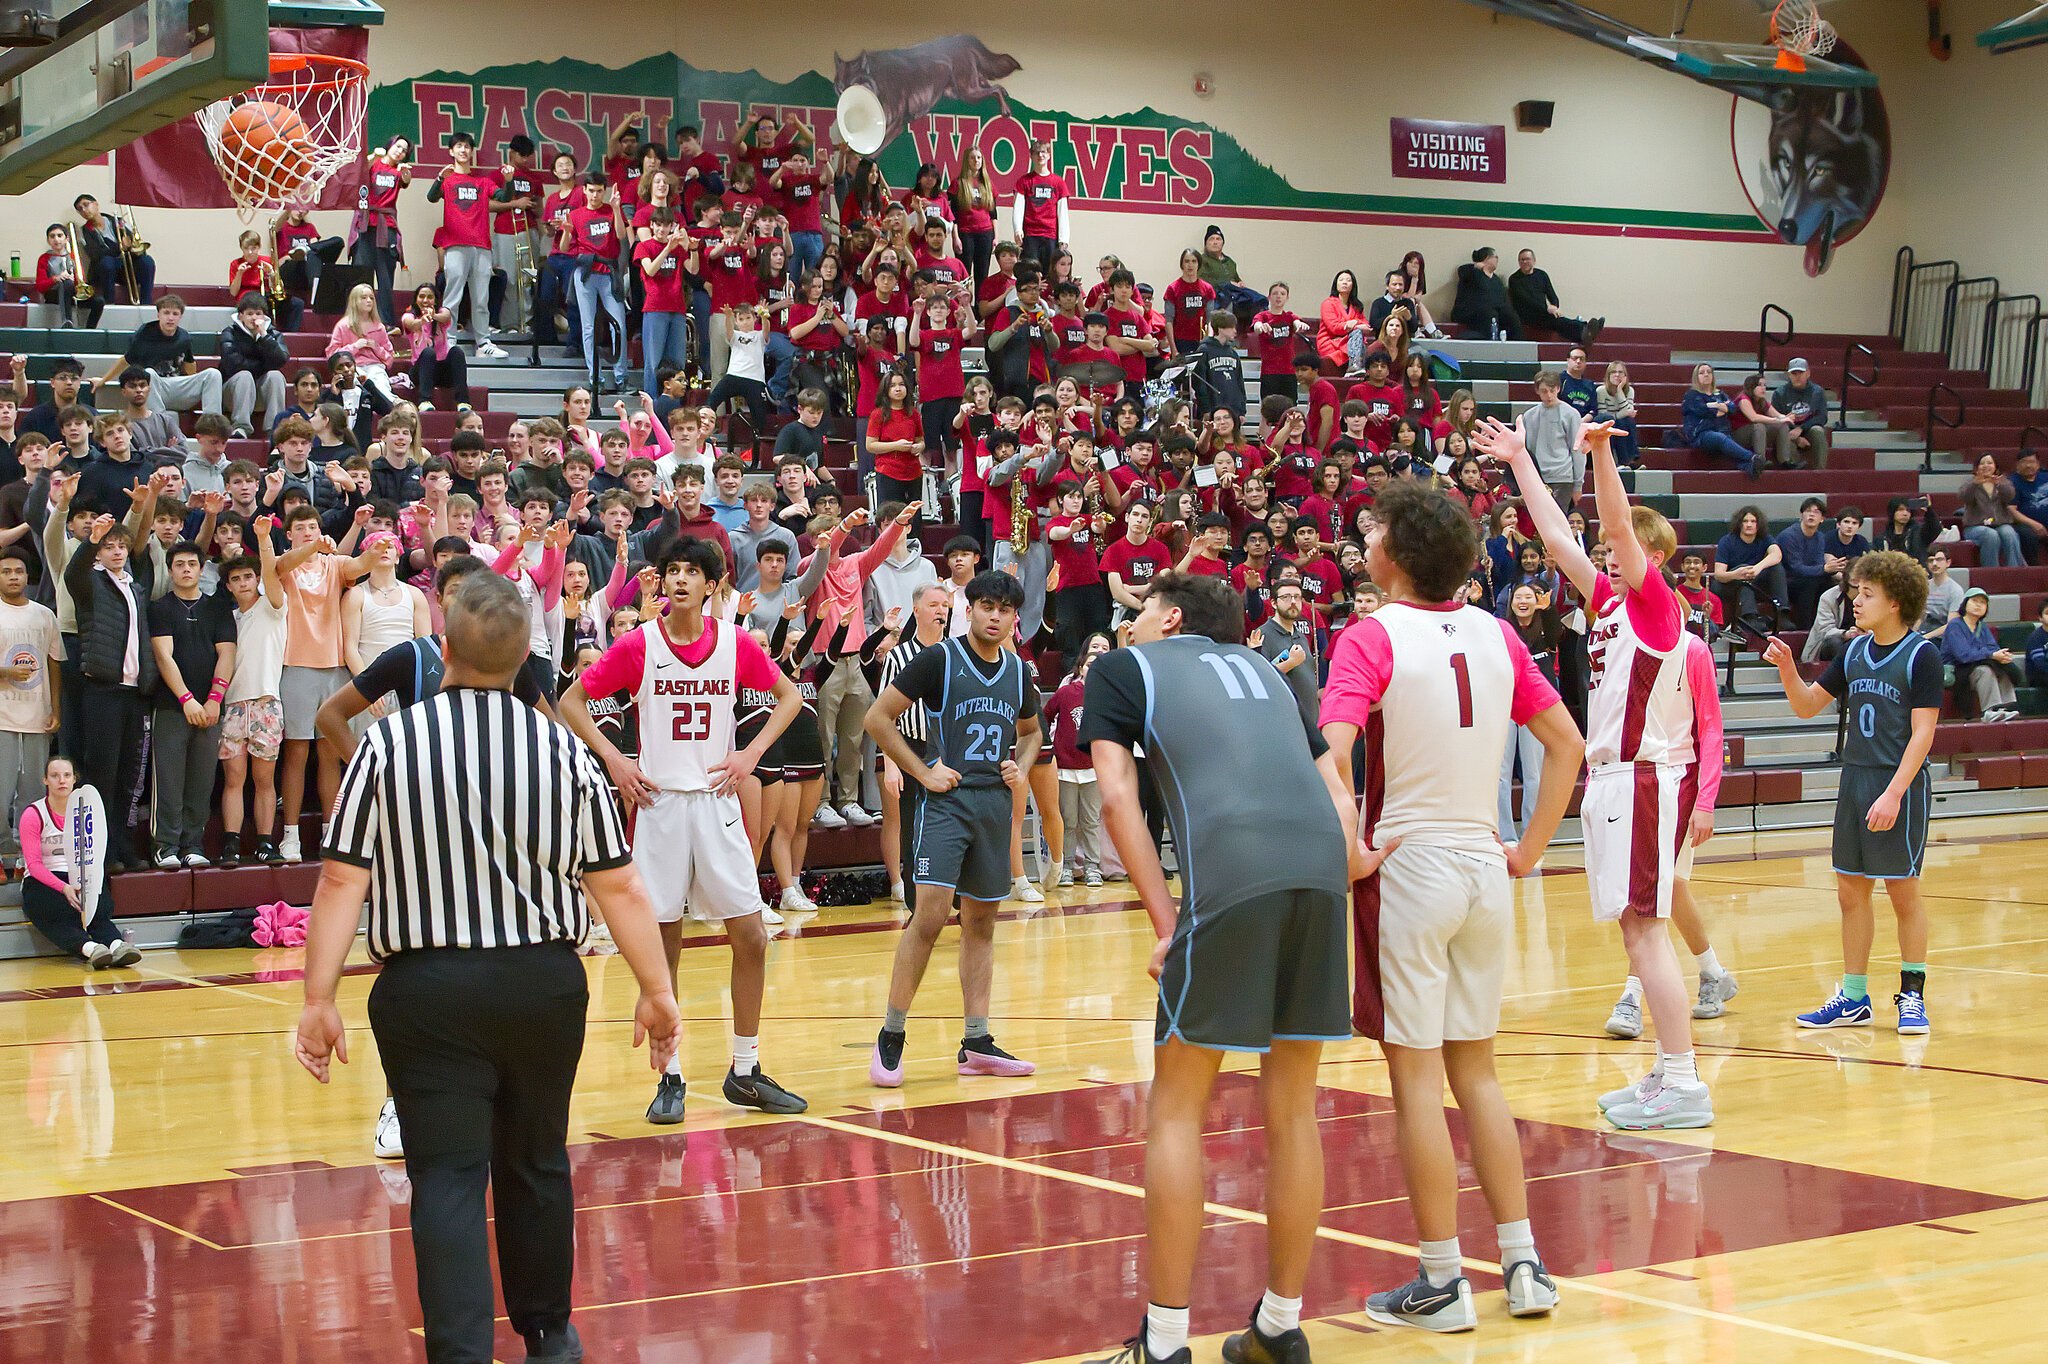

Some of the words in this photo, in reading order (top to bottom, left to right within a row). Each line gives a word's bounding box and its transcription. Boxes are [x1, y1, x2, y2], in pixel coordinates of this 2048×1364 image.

[411, 80, 840, 181] EASTLAK
[908, 113, 1215, 208] WOLVES
[1410, 133, 1486, 153] VISITING
[1408, 151, 1490, 172] STUDENTS
[653, 679, 730, 696] EASTLAKE
[1198, 652, 1270, 700] 11
[1449, 652, 1474, 728] 1
[672, 702, 712, 741] 23
[954, 696, 1015, 726] INTERLAKE
[1859, 702, 1877, 738] 0
[964, 723, 1003, 762] 23
[73, 813, 93, 837] BG
[74, 836, 94, 851] HAD
